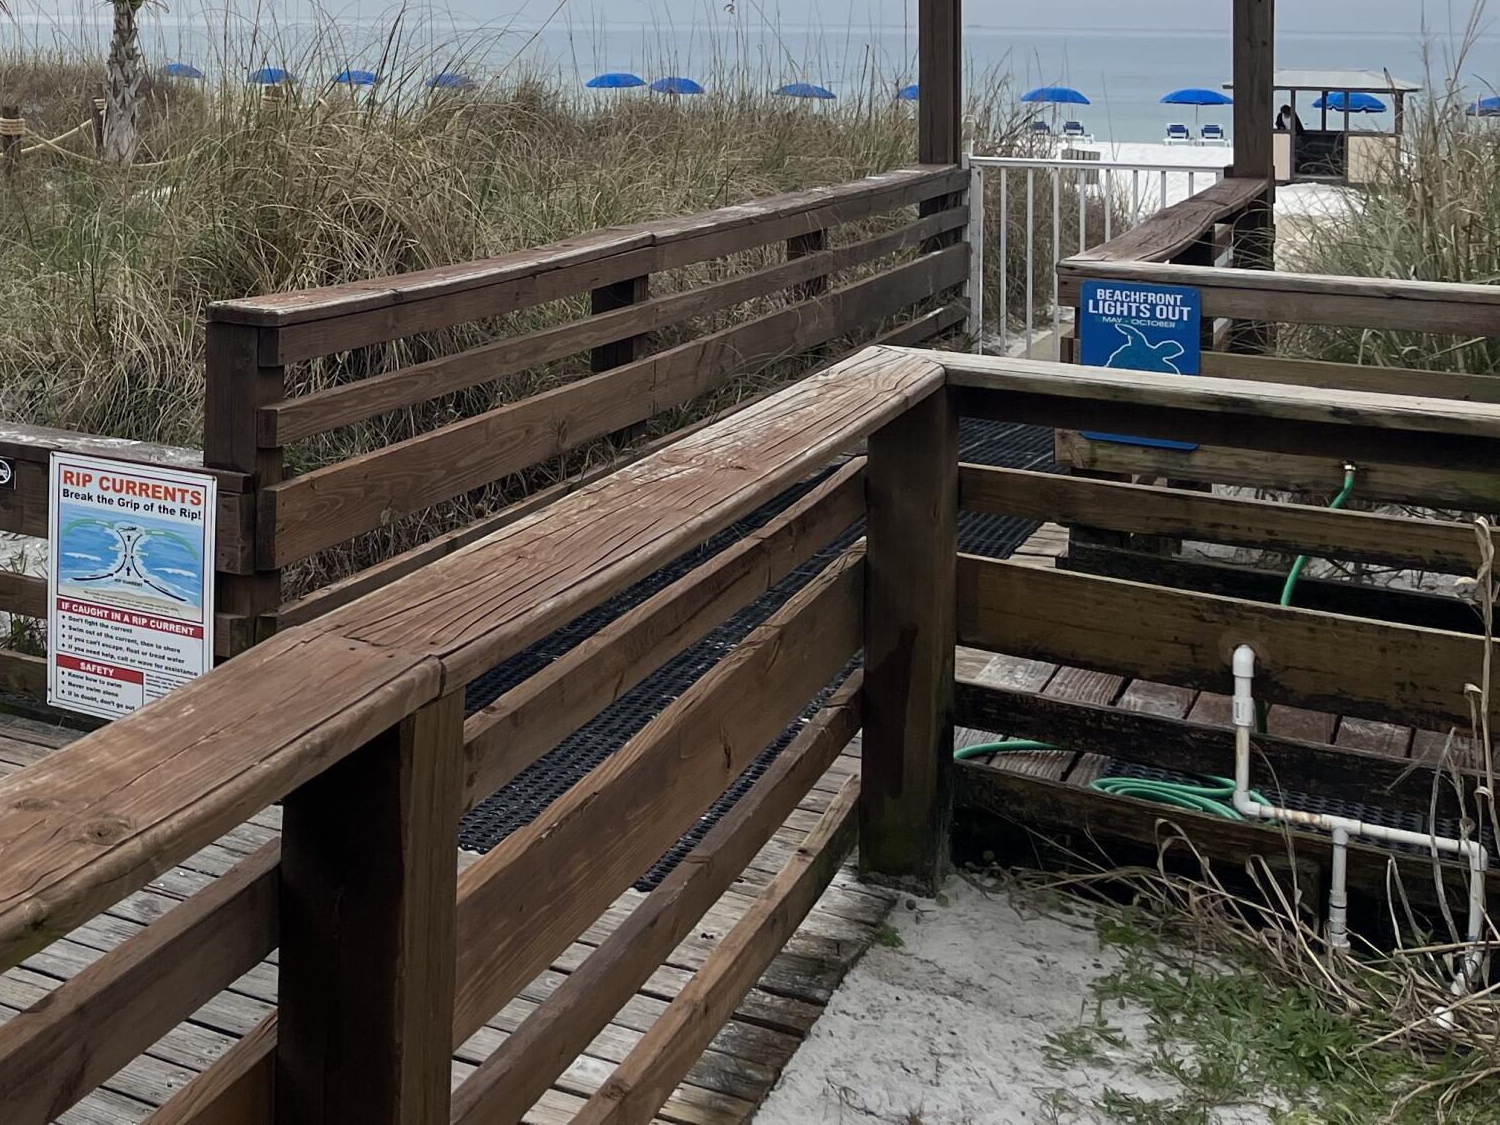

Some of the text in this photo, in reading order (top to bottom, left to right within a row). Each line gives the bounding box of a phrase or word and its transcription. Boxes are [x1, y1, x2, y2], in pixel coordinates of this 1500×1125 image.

[1096, 288, 1183, 306] BEACHFRONT
[1088, 299, 1191, 321] LIGHTS OUT
[1131, 318, 1176, 328] OCTOBER
[63, 470, 202, 506] RIP CURRENTS
[62, 488, 202, 521] Break the Grip of the Rip!
[61, 602, 195, 635] IF CAUGHT IN A RIP CURRENT
[68, 616, 83, 624] Don't
[84, 618, 99, 627] fight
[110, 625, 133, 634] current
[68, 625, 84, 633] Swim
[115, 635, 139, 646] current,
[140, 640, 154, 648] then
[163, 644, 181, 653] shore
[86, 638, 101, 647] can't
[126, 646, 140, 655] float
[149, 651, 166, 660] tread
[166, 655, 185, 664] water
[80, 662, 115, 676] SAFETY
[86, 647, 100, 655] need
[101, 650, 116, 660] help,
[117, 655, 129, 663] call
[137, 659, 153, 667] wave
[154, 661, 163, 669] for
[164, 665, 198, 676] assistance
[68, 681, 119, 697] Never swim alone
[106, 680, 122, 688] swim
[81, 693, 99, 703] doubt,
[100, 697, 115, 706] don't
